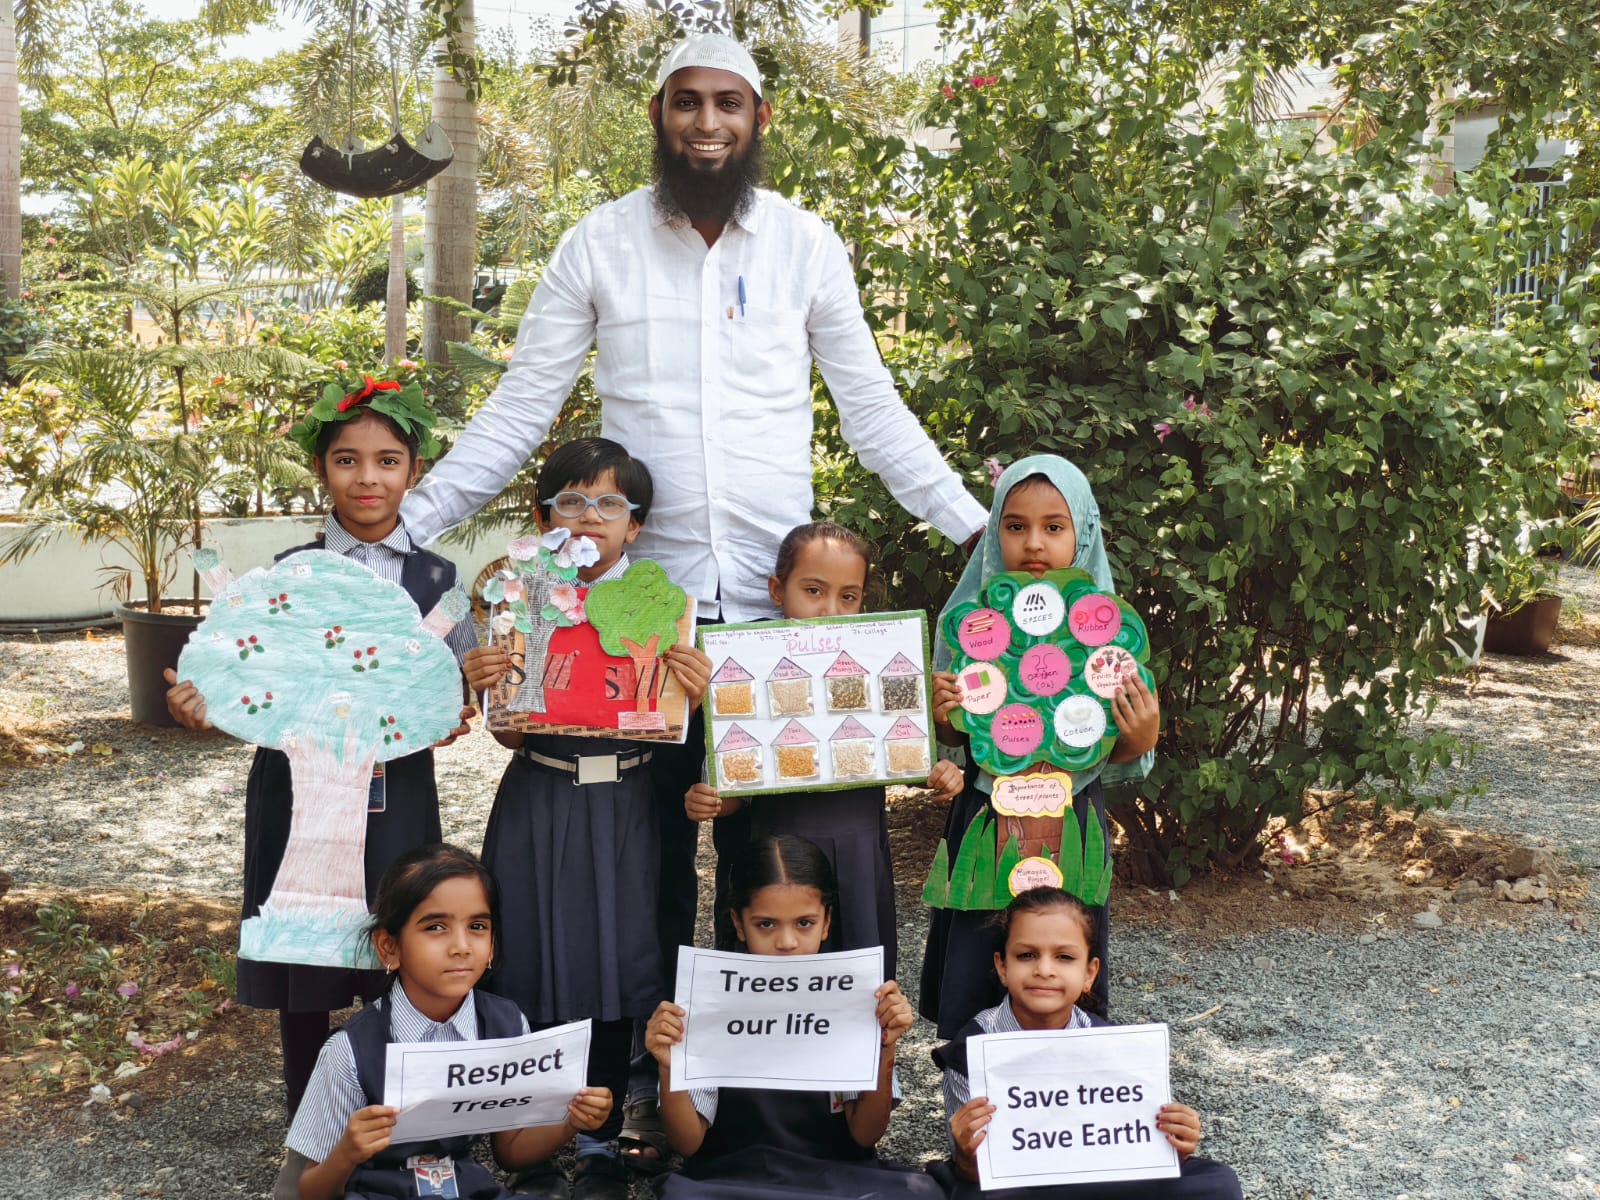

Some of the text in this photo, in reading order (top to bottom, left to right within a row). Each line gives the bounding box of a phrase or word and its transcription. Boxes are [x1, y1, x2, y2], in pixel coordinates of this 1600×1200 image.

[1023, 613, 1053, 625] SPICES
[1078, 623, 1109, 632] Rubber
[969, 637, 993, 648] Wood
[966, 692, 992, 704] Paper
[720, 969, 854, 992] Trees are
[727, 1012, 830, 1035] our life
[447, 1048, 564, 1089] Respect
[451, 1095, 533, 1113] Trees
[1008, 1084, 1143, 1109] Save trees
[1012, 1119, 1152, 1150] Save Earth
